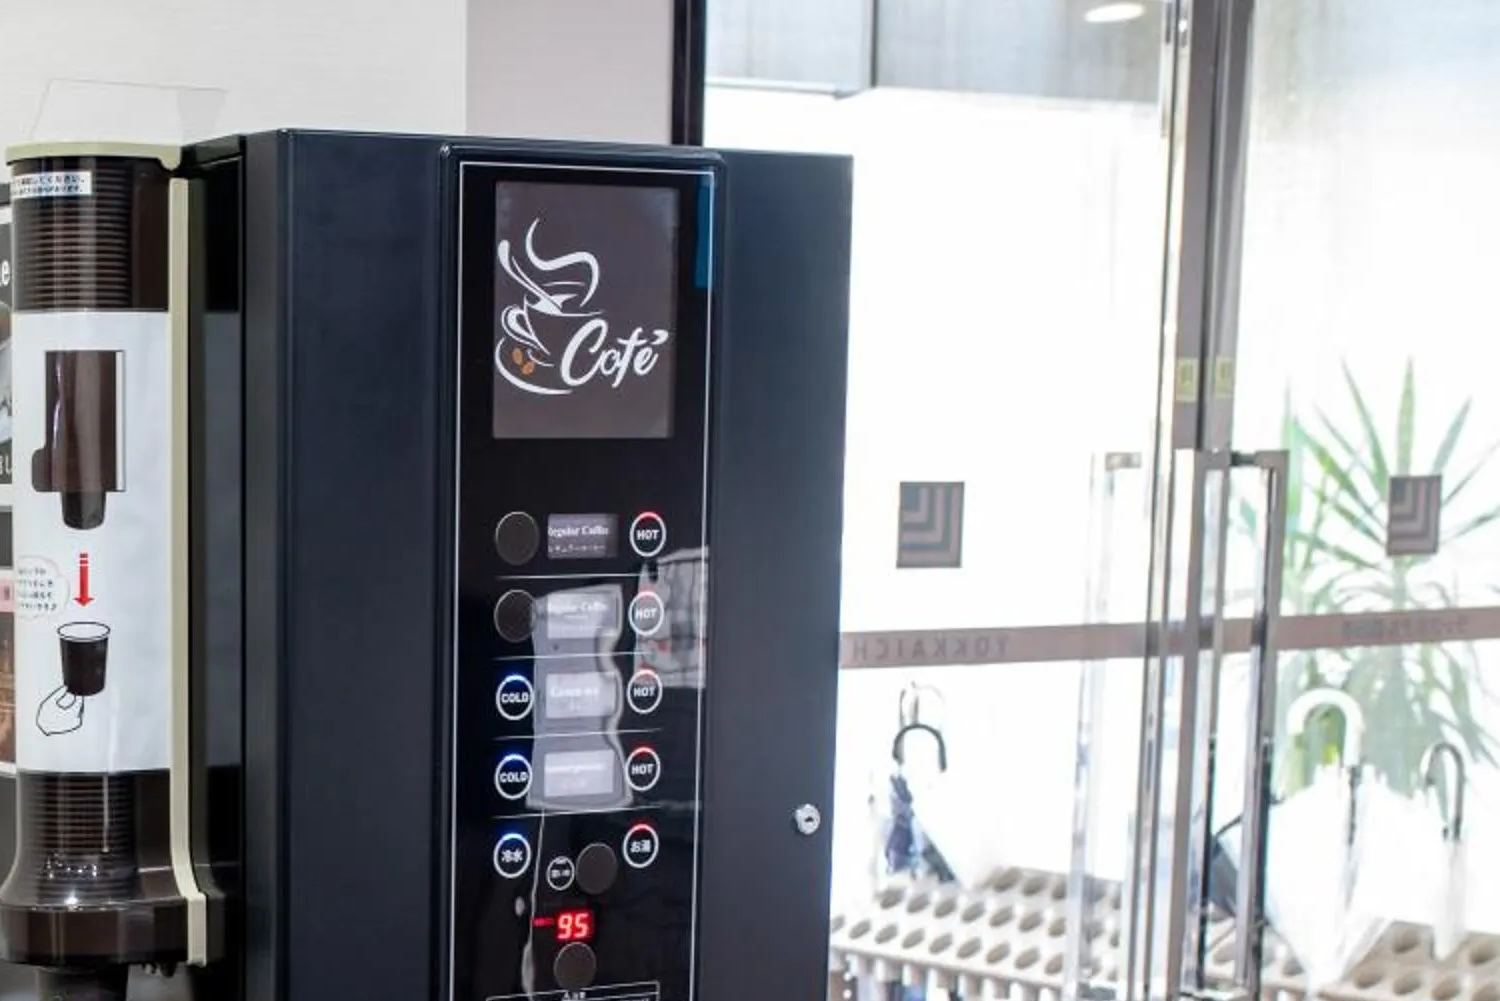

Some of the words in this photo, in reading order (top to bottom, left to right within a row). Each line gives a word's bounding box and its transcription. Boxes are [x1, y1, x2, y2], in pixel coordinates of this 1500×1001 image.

[636, 529, 659, 541] HOT
[634, 607, 657, 619] HOT
[633, 685, 655, 698] HOT
[500, 692, 529, 704] COLD
[631, 763, 654, 775] HOT
[499, 771, 528, 783] COLD
[556, 912, 591, 940] 95
